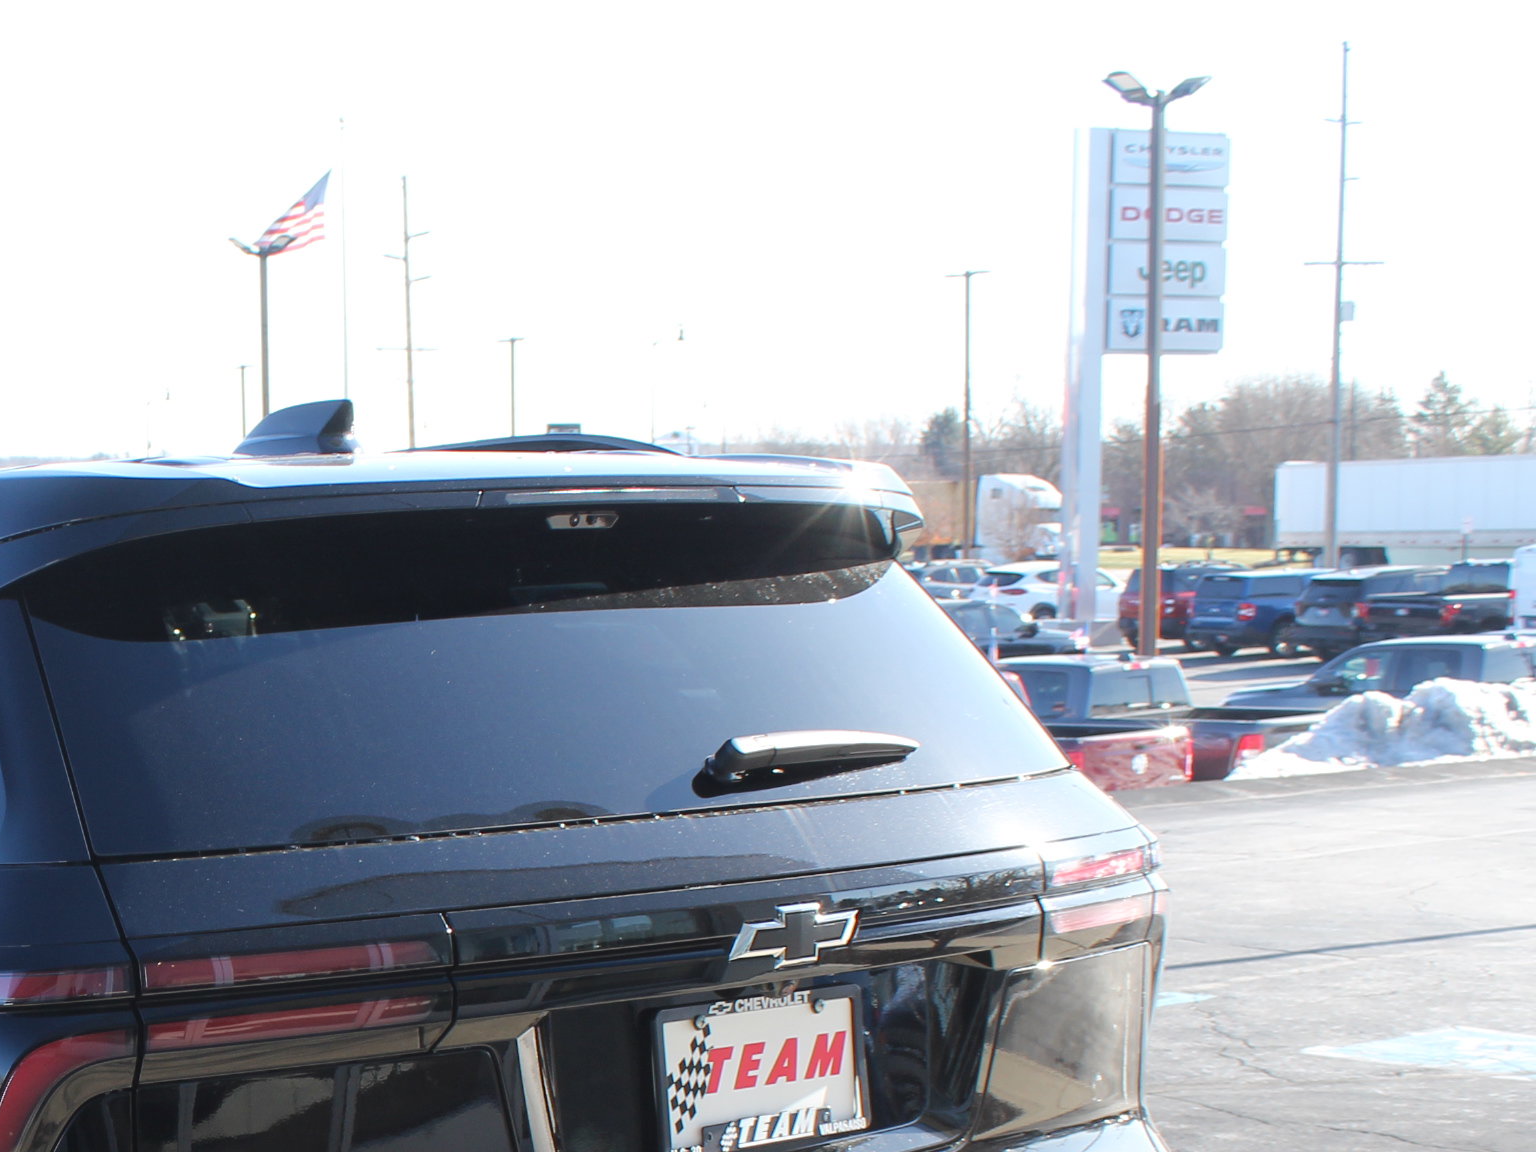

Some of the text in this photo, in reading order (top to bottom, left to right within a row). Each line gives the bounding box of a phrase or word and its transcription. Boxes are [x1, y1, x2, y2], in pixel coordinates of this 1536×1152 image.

[1124, 143, 1224, 156] CHYSLER
[734, 990, 812, 1013] CHEVROLET
[705, 1030, 848, 1095] TEAM
[737, 1107, 815, 1148] TEAM
